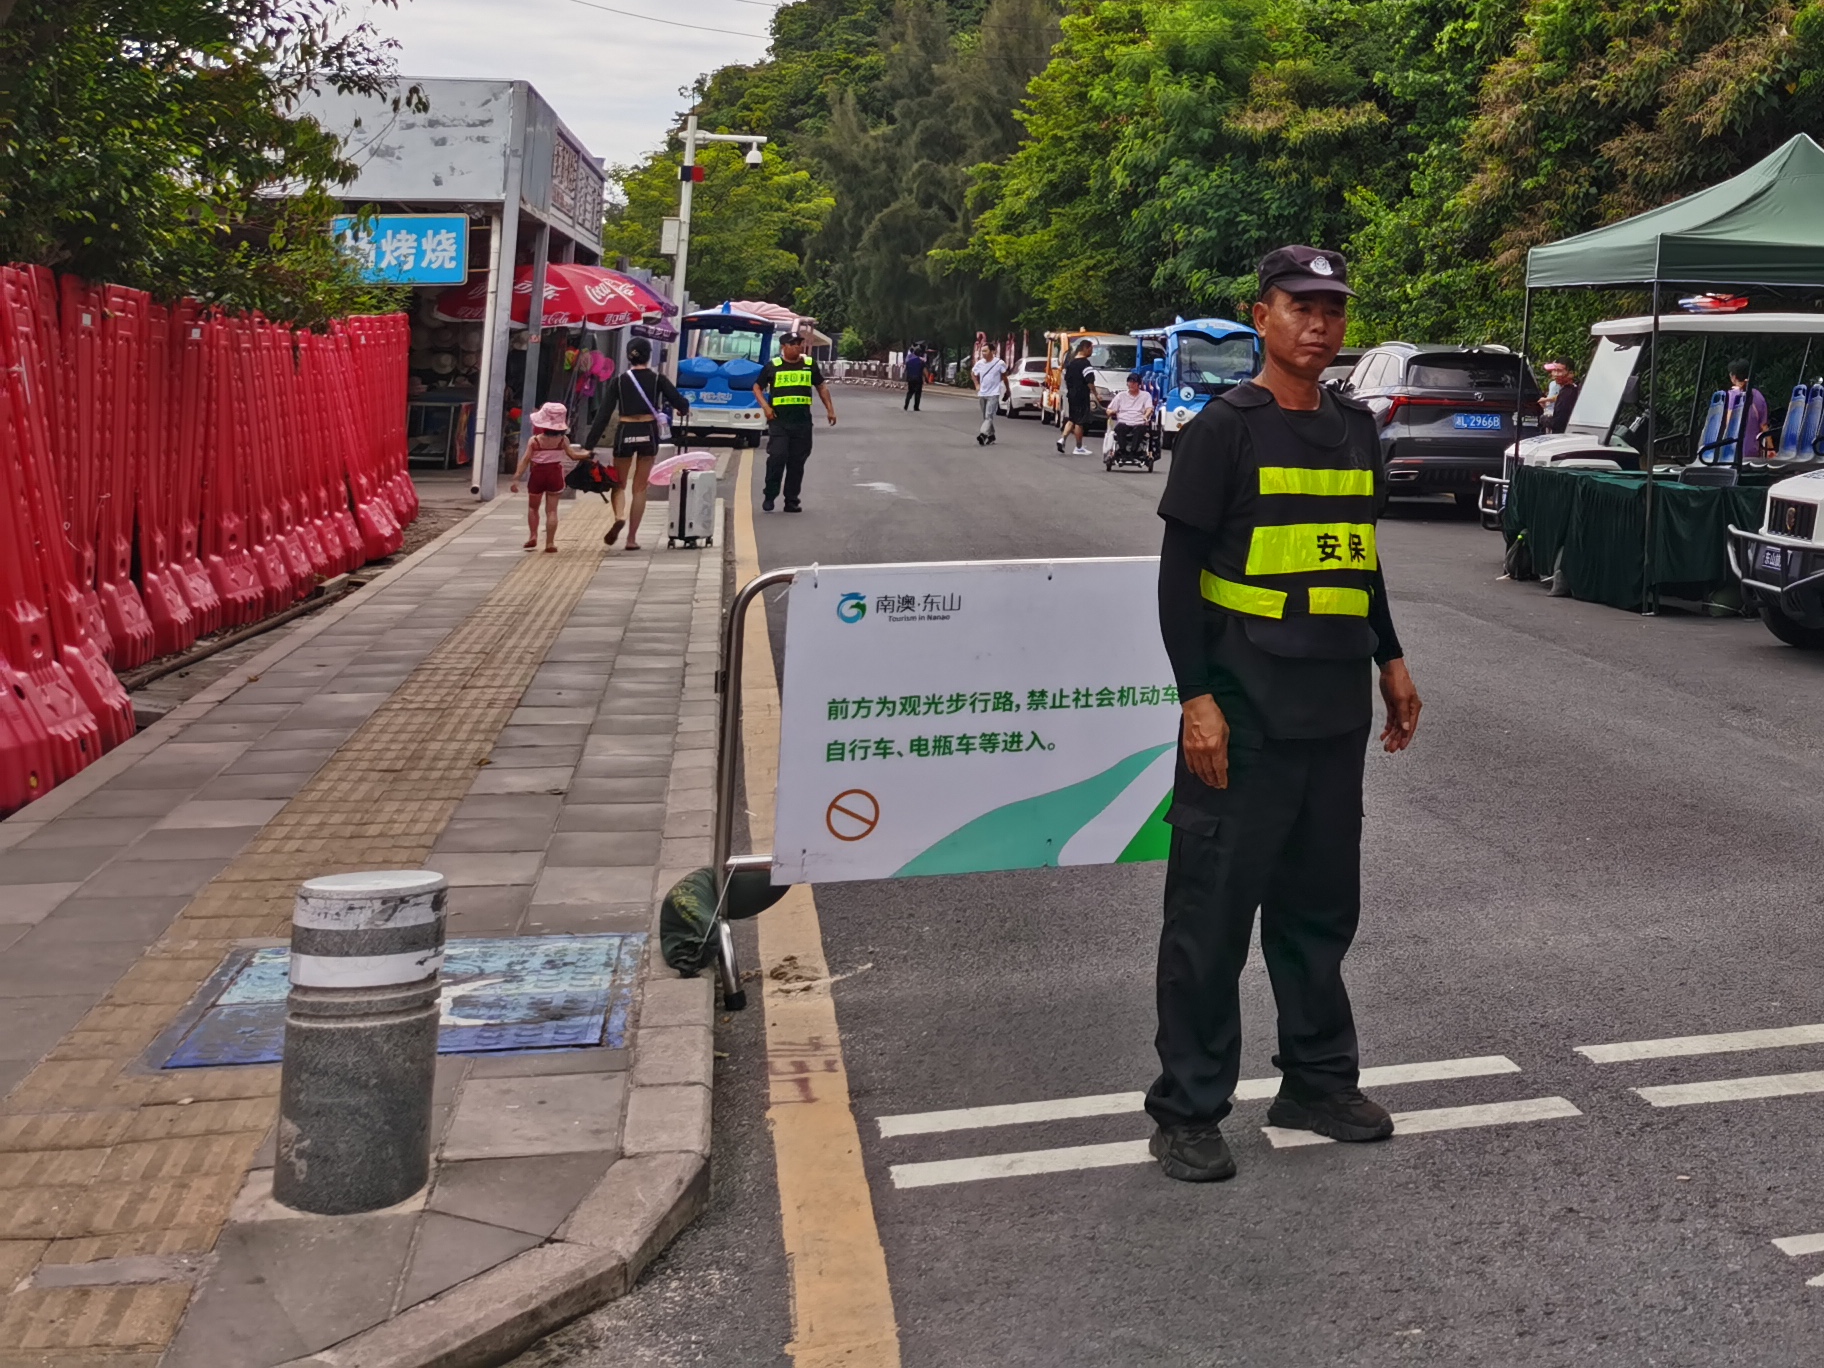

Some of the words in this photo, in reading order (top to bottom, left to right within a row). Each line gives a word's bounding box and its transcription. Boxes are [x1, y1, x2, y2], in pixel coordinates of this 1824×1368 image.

[1317, 533, 1366, 563] 安保
[876, 593, 961, 613] 南澳·东山
[825, 731, 1056, 762] 自行车、电瓶车等进入。
